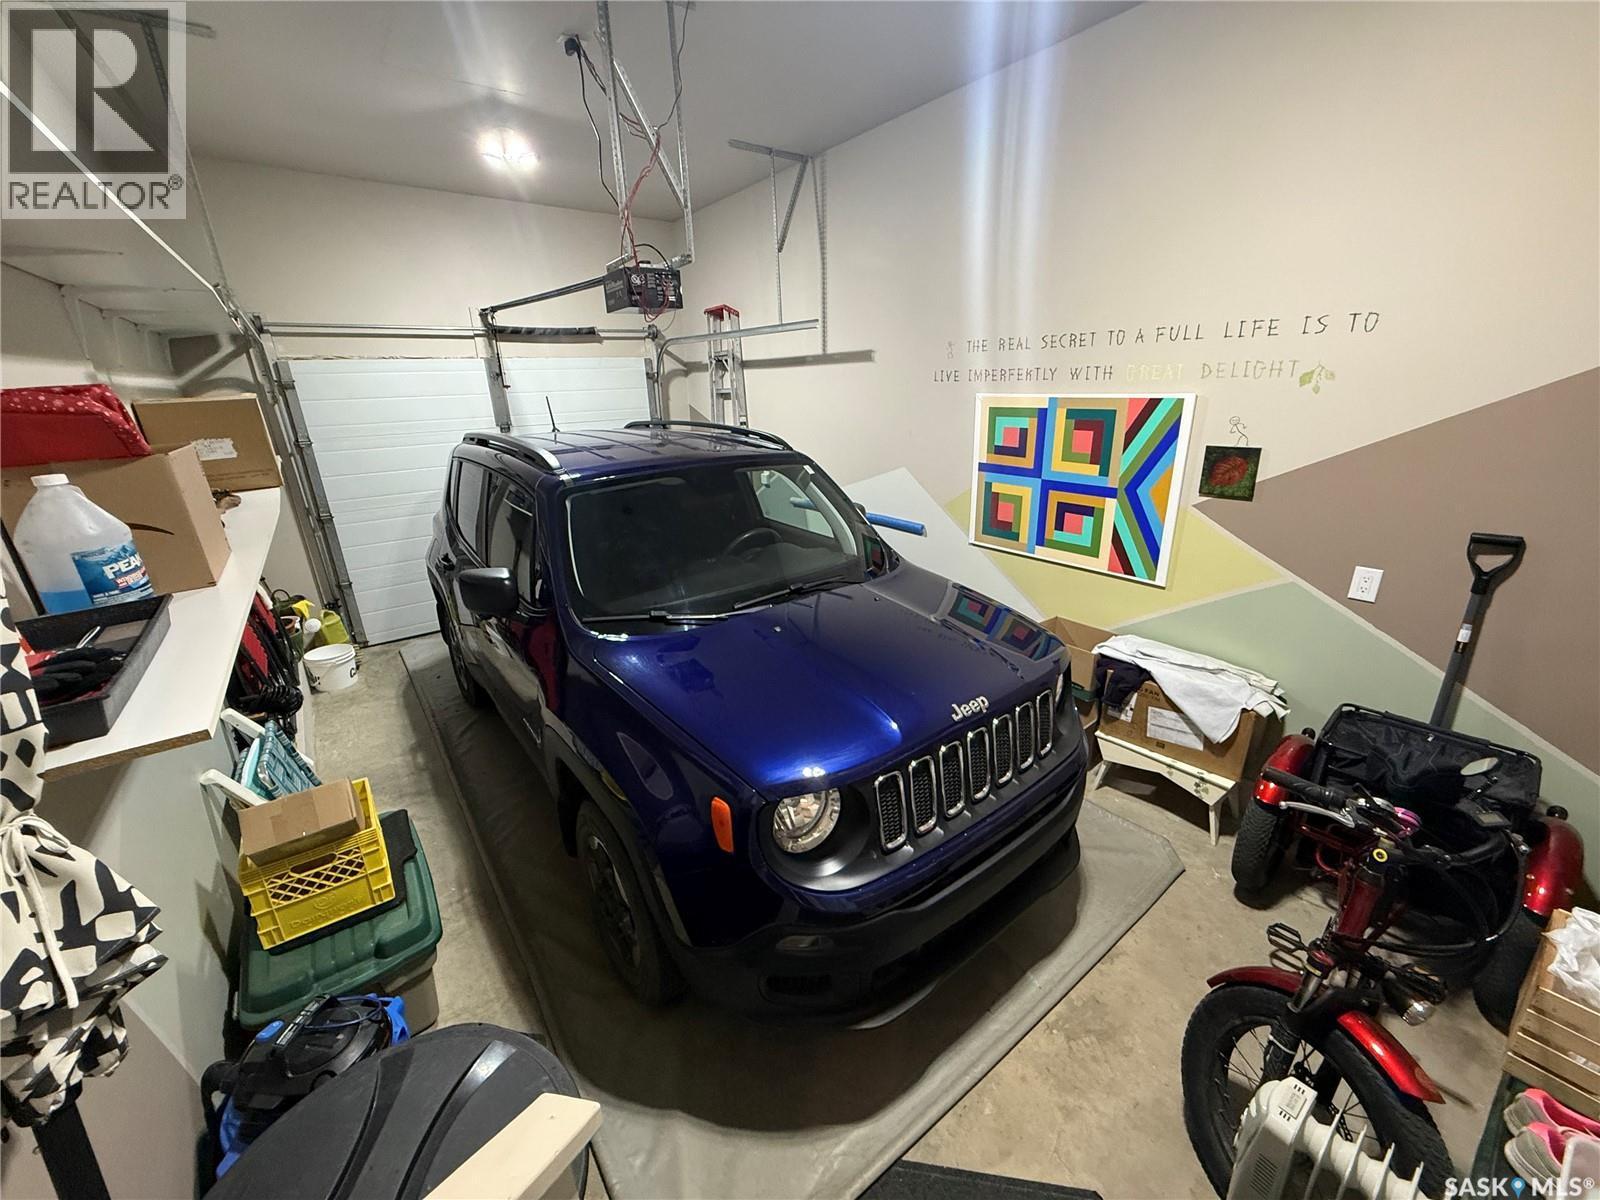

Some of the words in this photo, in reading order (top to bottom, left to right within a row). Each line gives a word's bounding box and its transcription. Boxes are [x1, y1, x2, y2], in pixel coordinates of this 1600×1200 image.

[966, 338, 988, 353] THE
[998, 336, 1031, 352] REAL
[1040, 331, 1097, 350] SECRET
[1107, 329, 1126, 346] TO
[1134, 328, 1144, 344] A
[1155, 323, 1205, 343] FULL
[1223, 318, 1281, 339] LIFE
[1301, 313, 1331, 335] IS
[1348, 311, 1381, 333] TO
[933, 369, 960, 383] LIVE
[1069, 365, 1114, 382] WITH
[1126, 363, 1185, 382] GREAT
[1200, 359, 1300, 380] DELIGHT
[951, 695, 989, 722] Jeep
